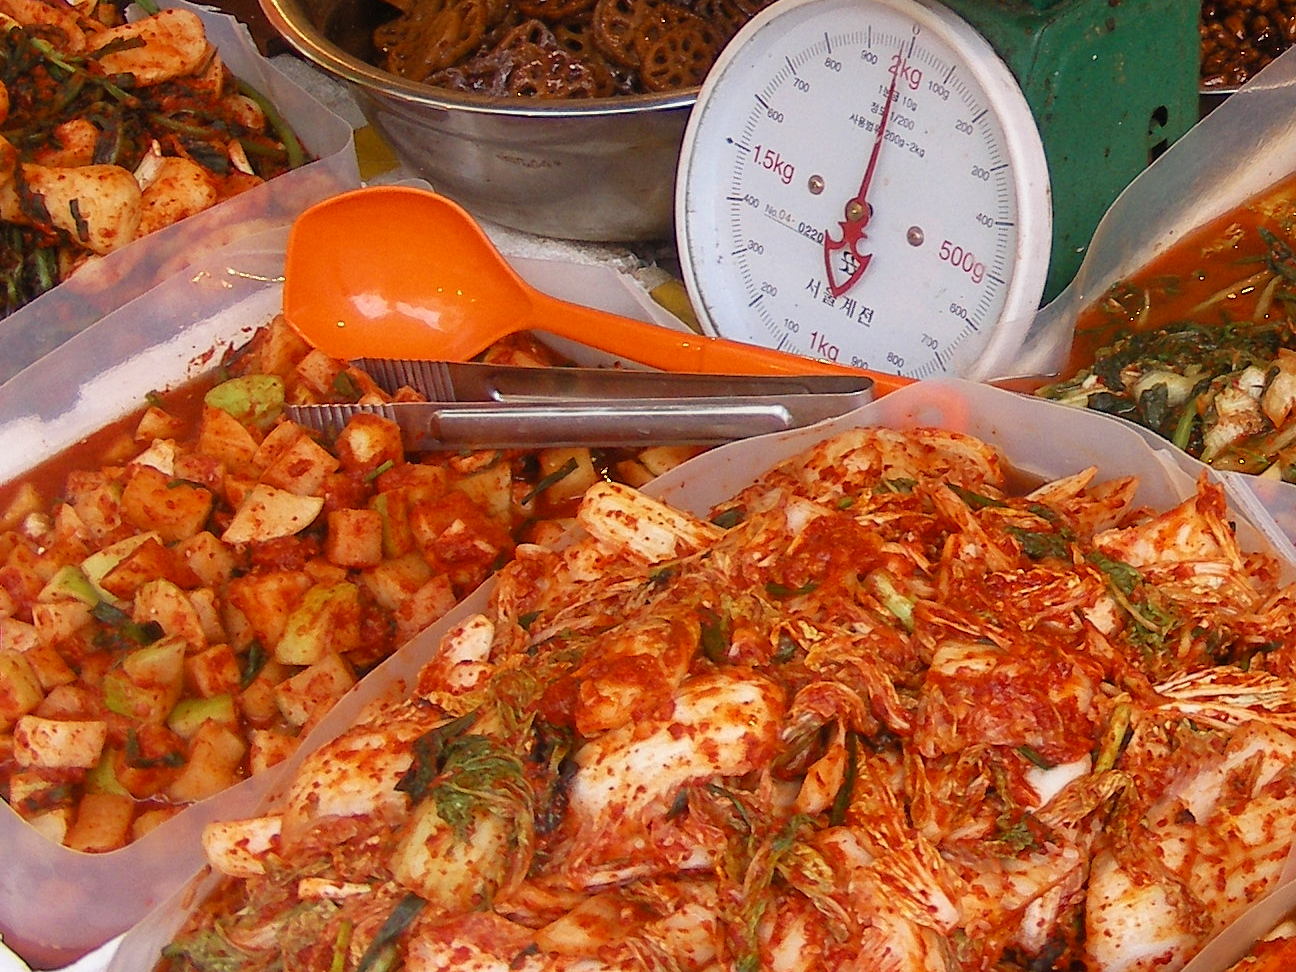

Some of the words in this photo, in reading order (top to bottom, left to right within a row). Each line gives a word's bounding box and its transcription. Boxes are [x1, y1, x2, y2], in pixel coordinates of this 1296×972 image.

[824, 57, 842, 72] 800
[861, 50, 878, 65] 900
[888, 55, 922, 90] 2kg
[793, 77, 810, 93] 700
[928, 80, 950, 101] 100g
[767, 108, 784, 123] 600
[890, 111, 915, 130] 1/200
[955, 119, 974, 136] 200
[754, 144, 795, 185] 1.5kg
[743, 194, 760, 208] 400
[975, 212, 994, 228] 400
[747, 239, 765, 255] 300
[939, 239, 987, 284] 500g
[761, 281, 778, 297] 200
[784, 318, 800, 333] 100
[921, 333, 939, 350] 700
[886, 351, 905, 368] 800
